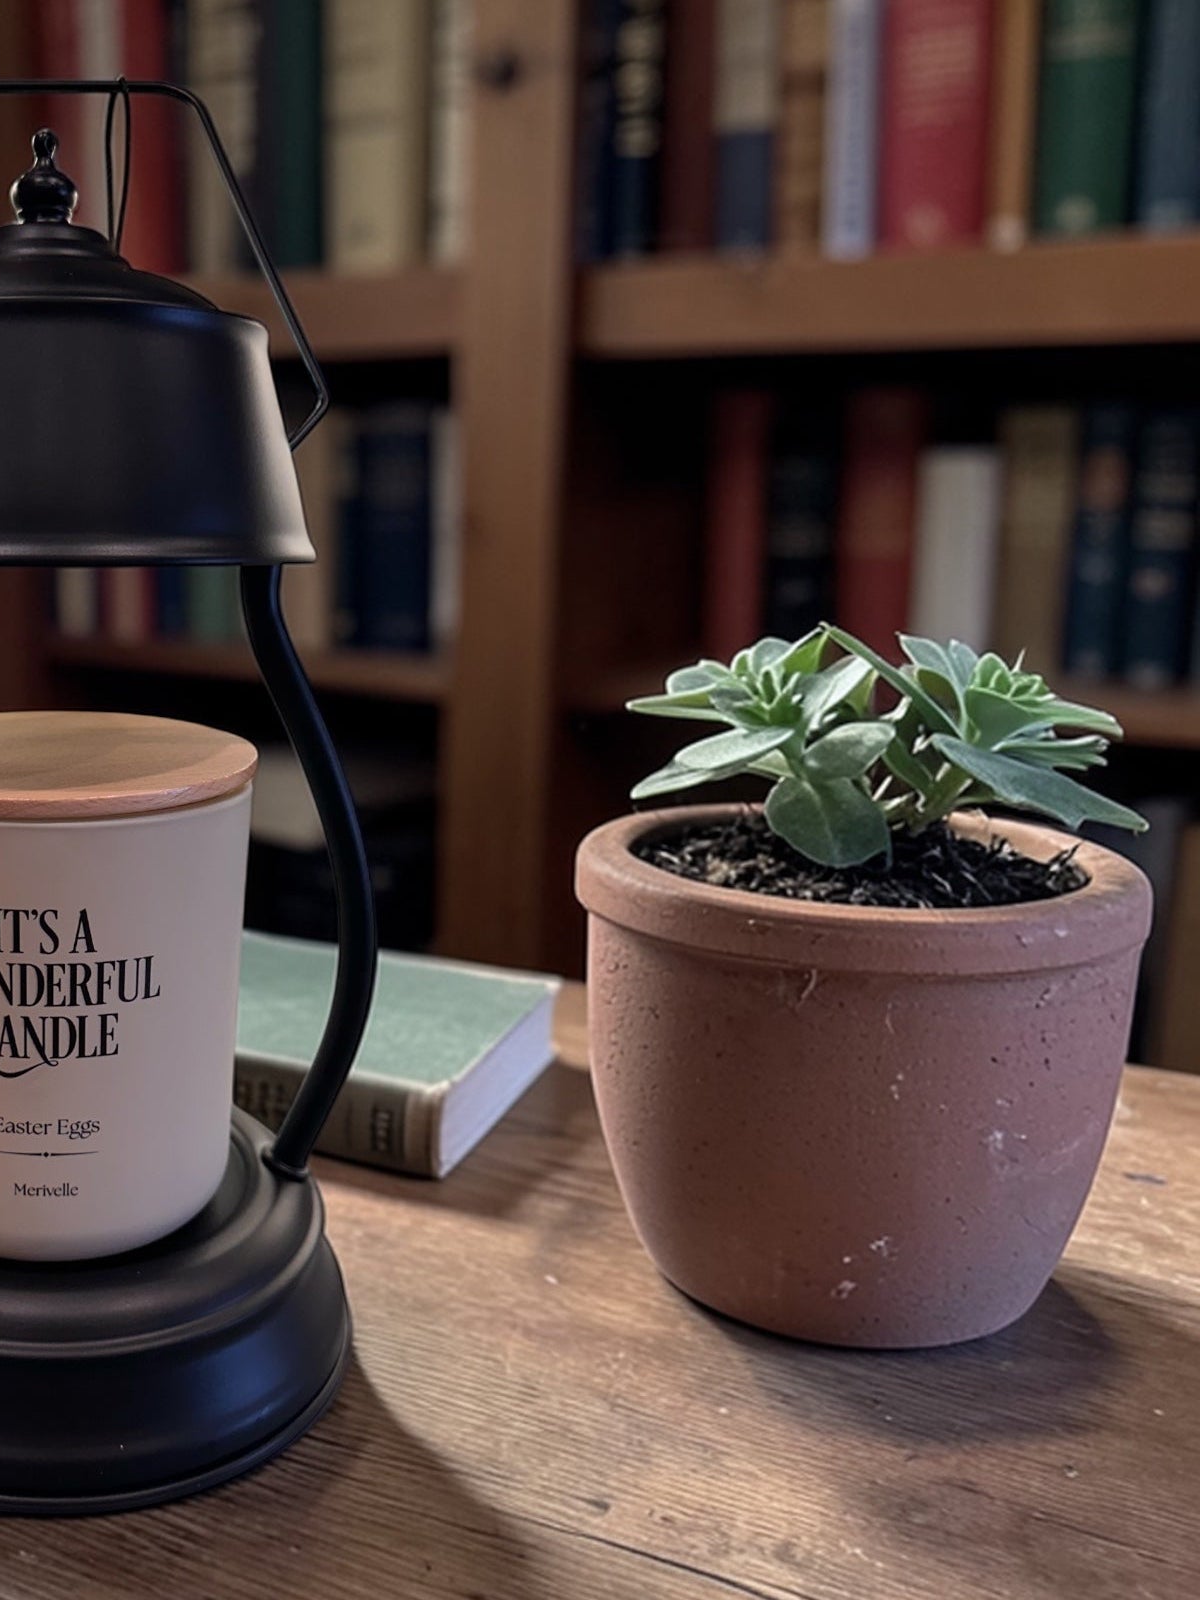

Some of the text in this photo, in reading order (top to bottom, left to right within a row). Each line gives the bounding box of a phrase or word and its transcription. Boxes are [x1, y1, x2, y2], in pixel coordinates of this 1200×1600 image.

[69, 908, 97, 953] A
[57, 1119, 100, 1139] Eggs
[13, 1183, 79, 1197] Merivelle
